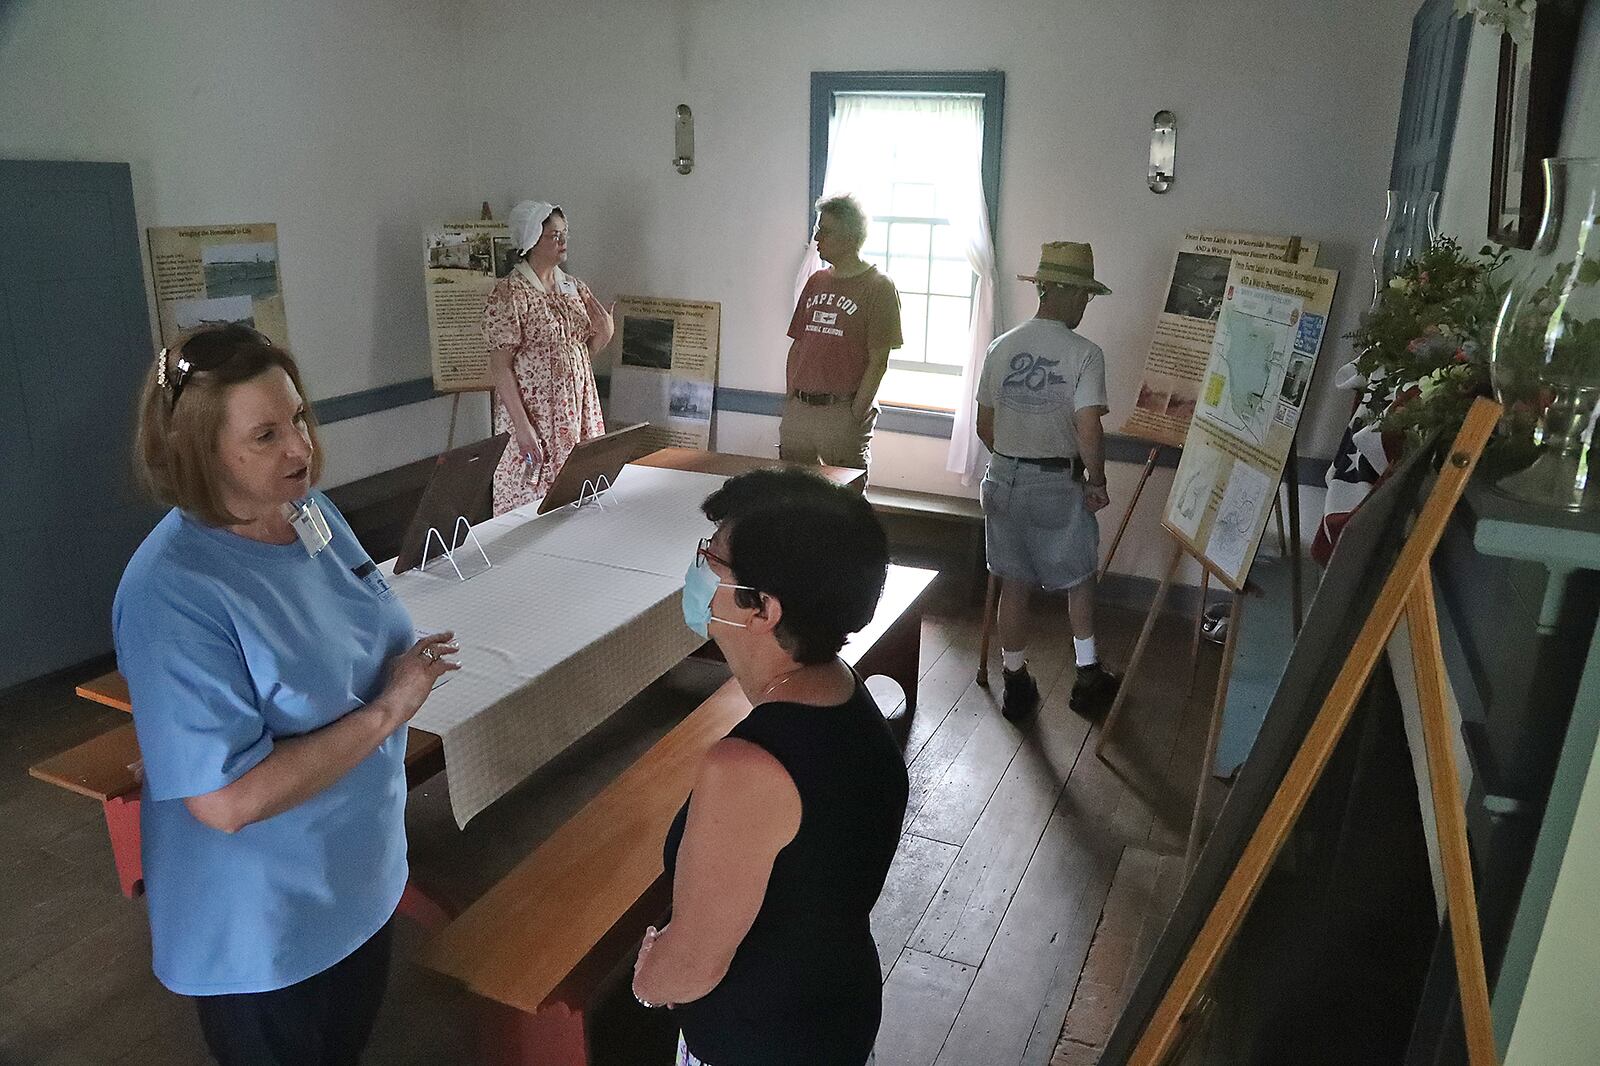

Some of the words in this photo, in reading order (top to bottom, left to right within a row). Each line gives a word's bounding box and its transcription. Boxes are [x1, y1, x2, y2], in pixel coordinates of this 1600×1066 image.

[1213, 236, 1227, 244] Land
[806, 293, 835, 309] CAPE
[836, 295, 858, 316] COD
[1002, 352, 1060, 392] 25
